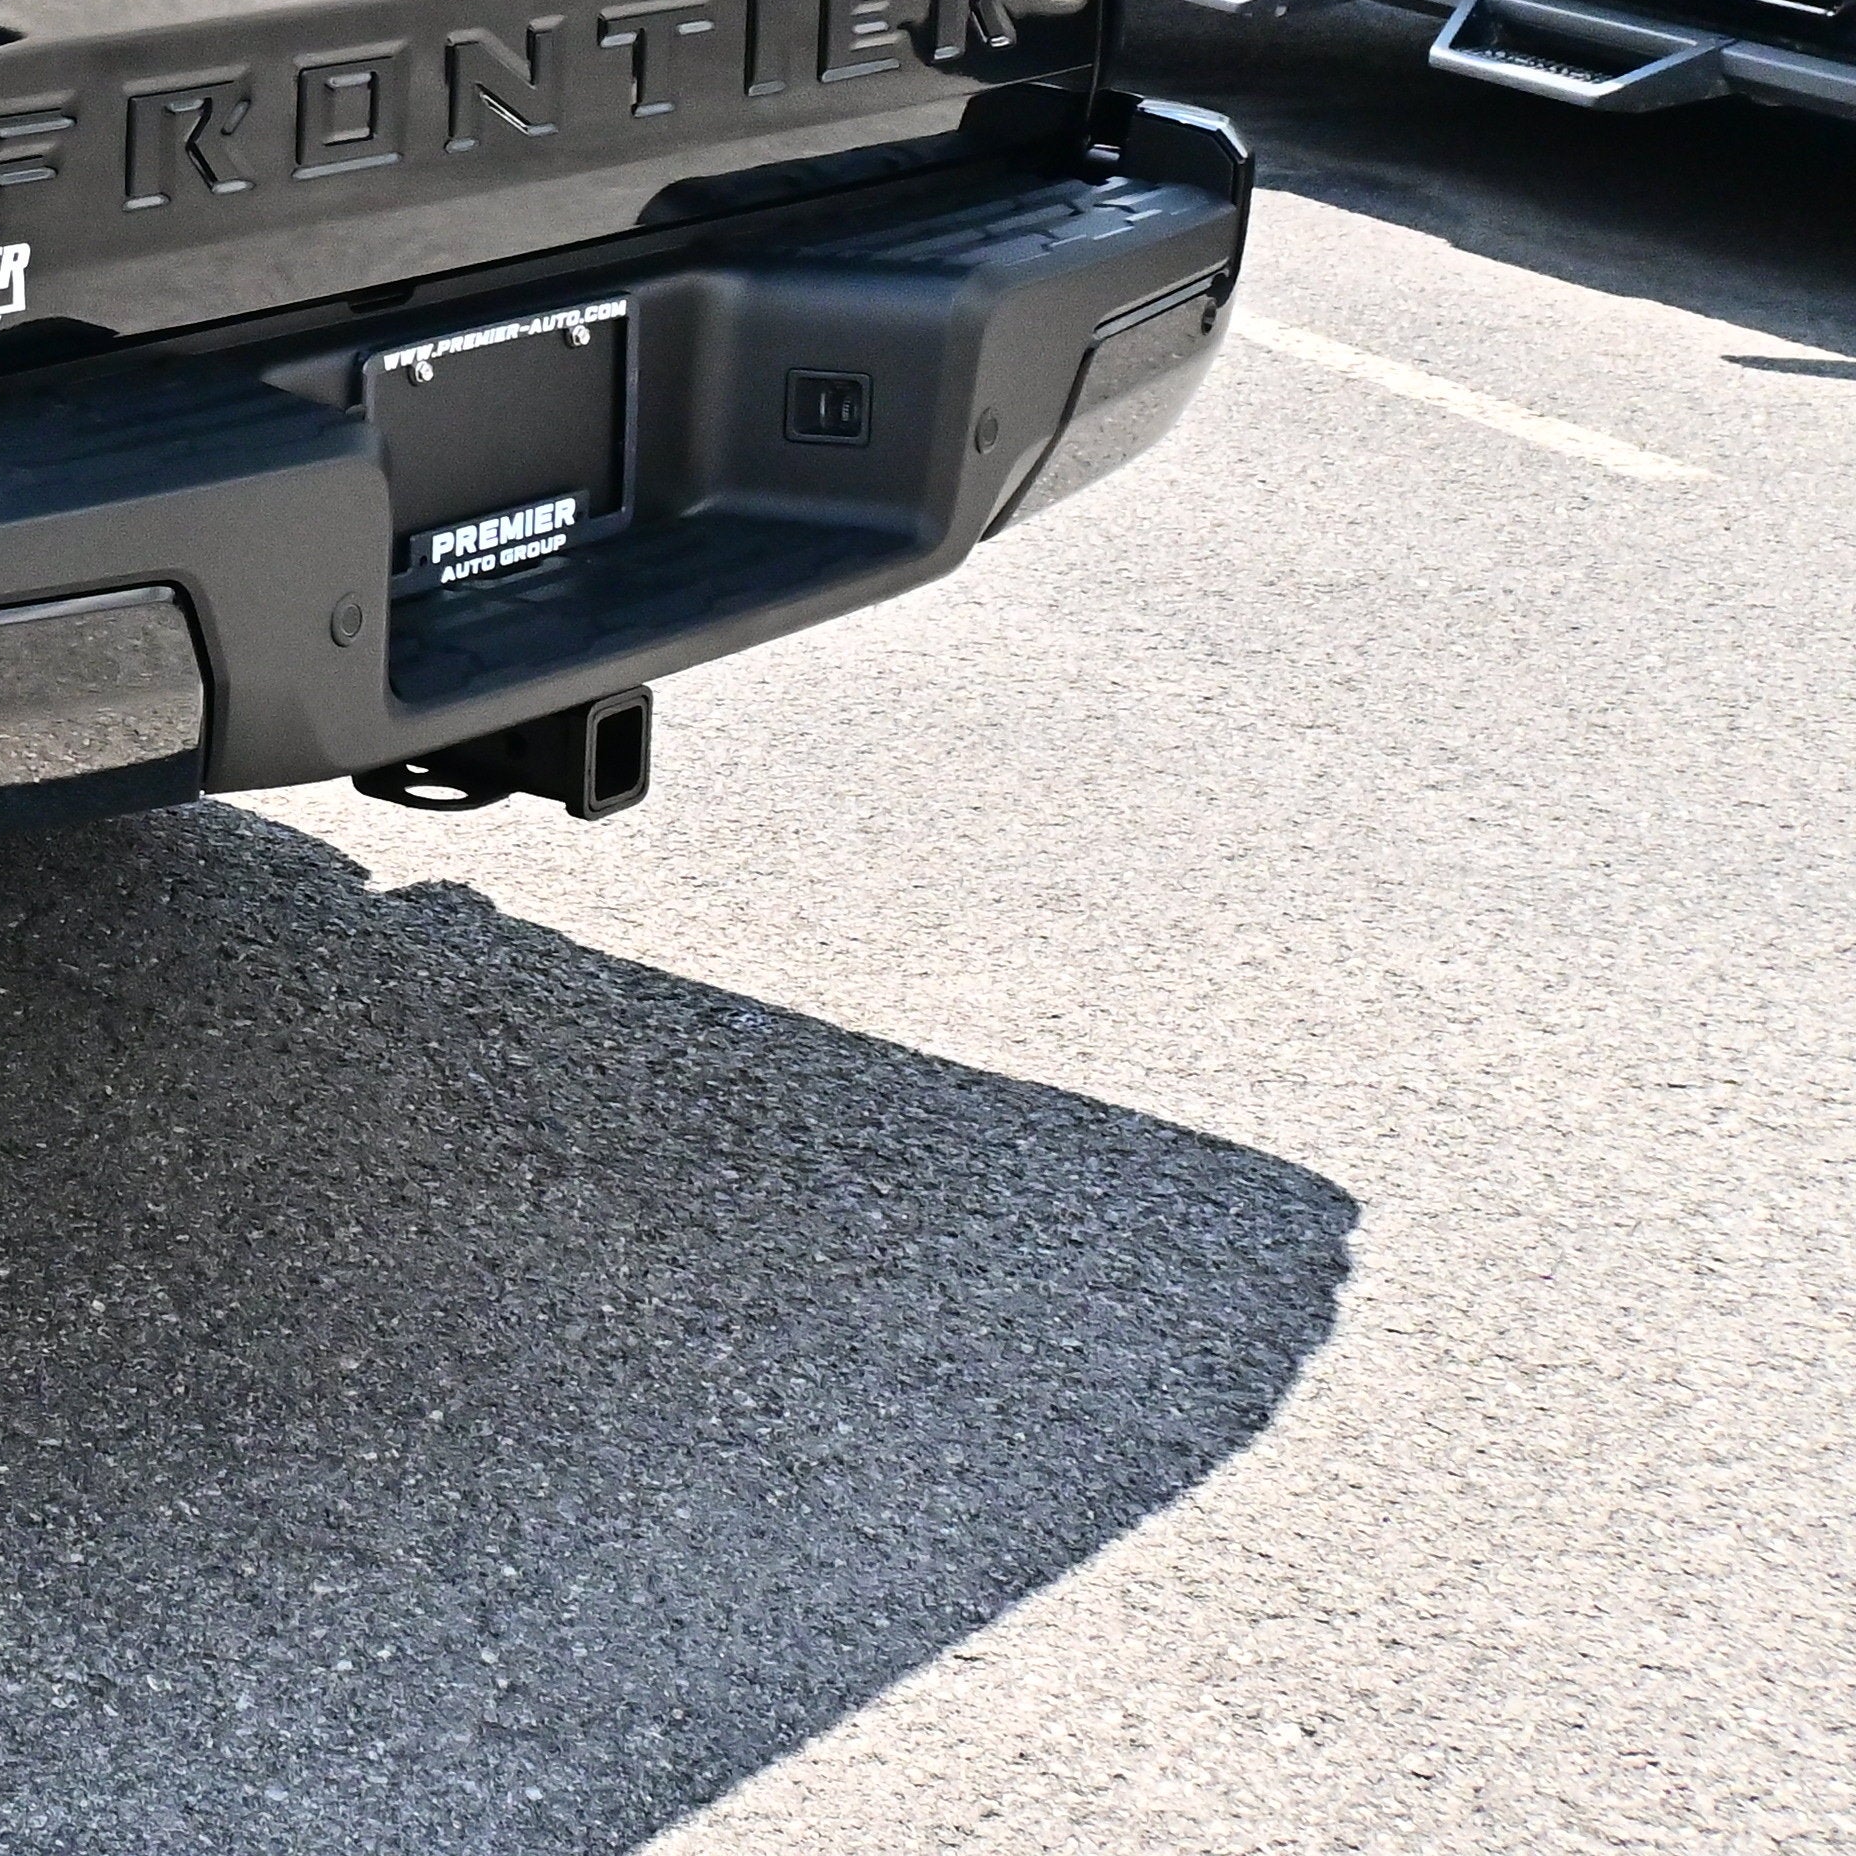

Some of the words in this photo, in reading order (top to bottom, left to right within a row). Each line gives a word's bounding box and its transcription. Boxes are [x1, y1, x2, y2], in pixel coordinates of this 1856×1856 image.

[383, 299, 627, 372] WWW.PREMIER-AUTO.COM
[431, 497, 576, 564] PREMIER
[440, 553, 496, 584] AUTO
[499, 533, 567, 566] GROUP
